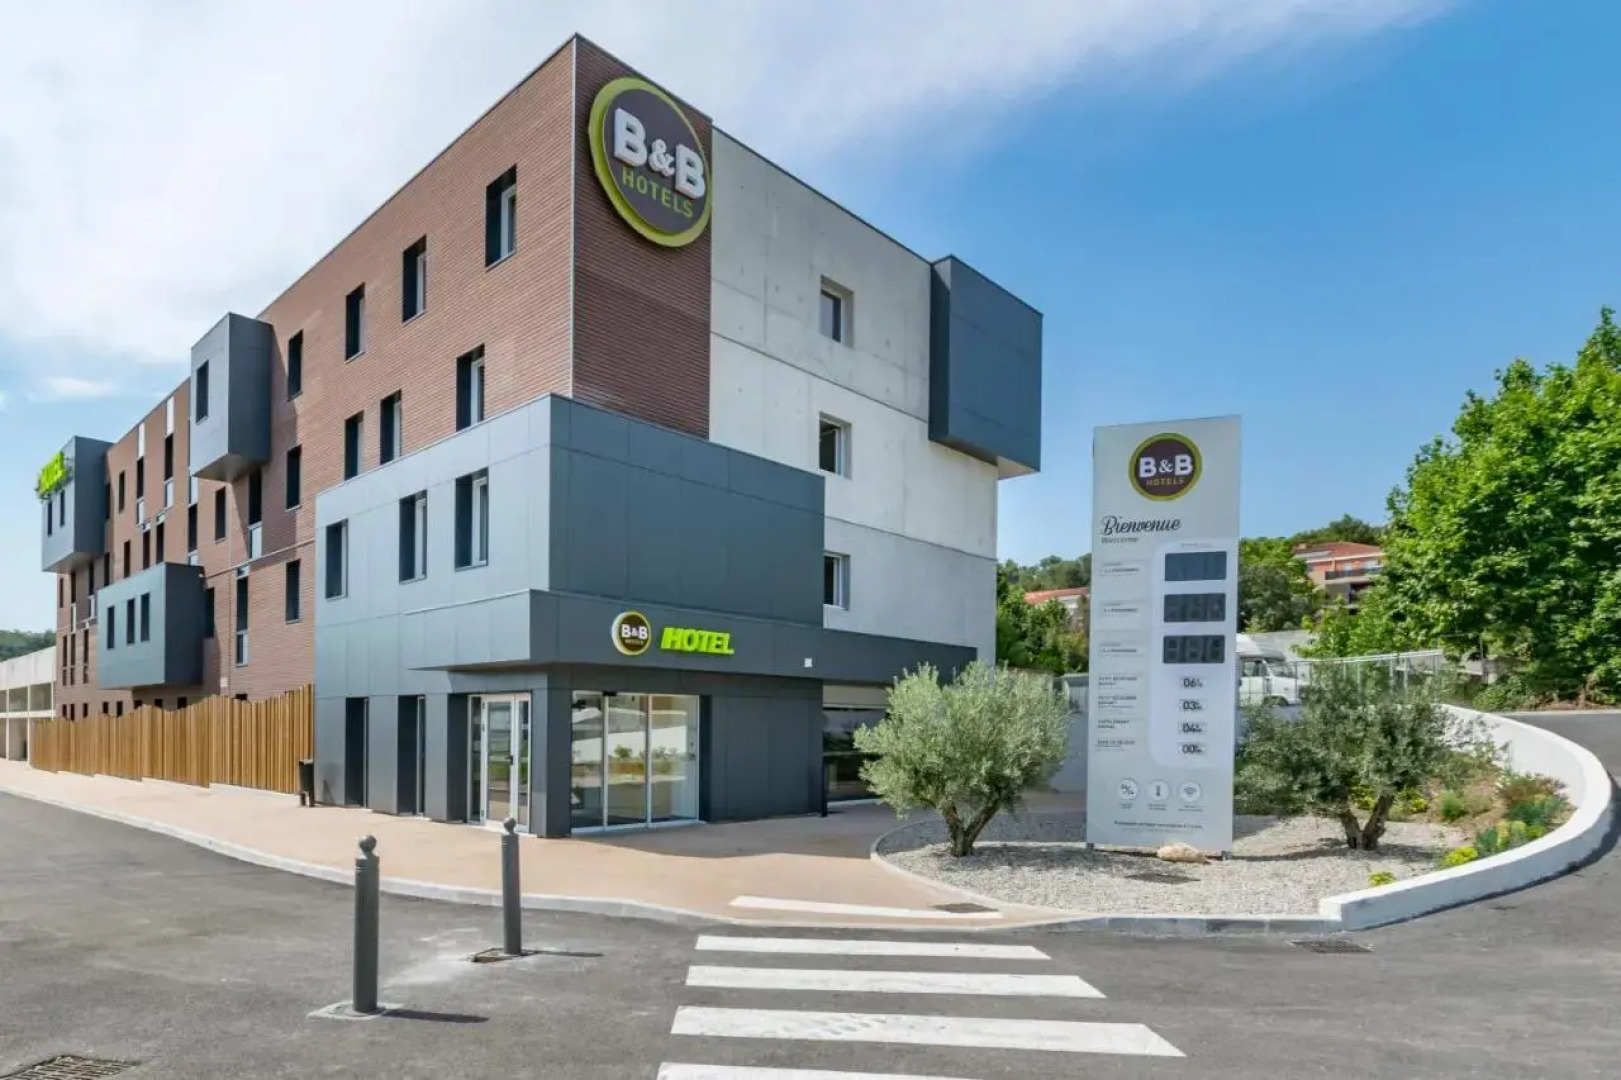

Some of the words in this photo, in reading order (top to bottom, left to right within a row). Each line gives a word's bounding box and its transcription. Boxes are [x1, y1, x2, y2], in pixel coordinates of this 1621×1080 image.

[614, 107, 706, 199] B&B
[622, 166, 694, 218] HOTELS
[1139, 454, 1194, 477] B&B
[1101, 515, 1181, 535] Bienvenue
[621, 623, 648, 639] B&B
[660, 627, 735, 655] HOTEL
